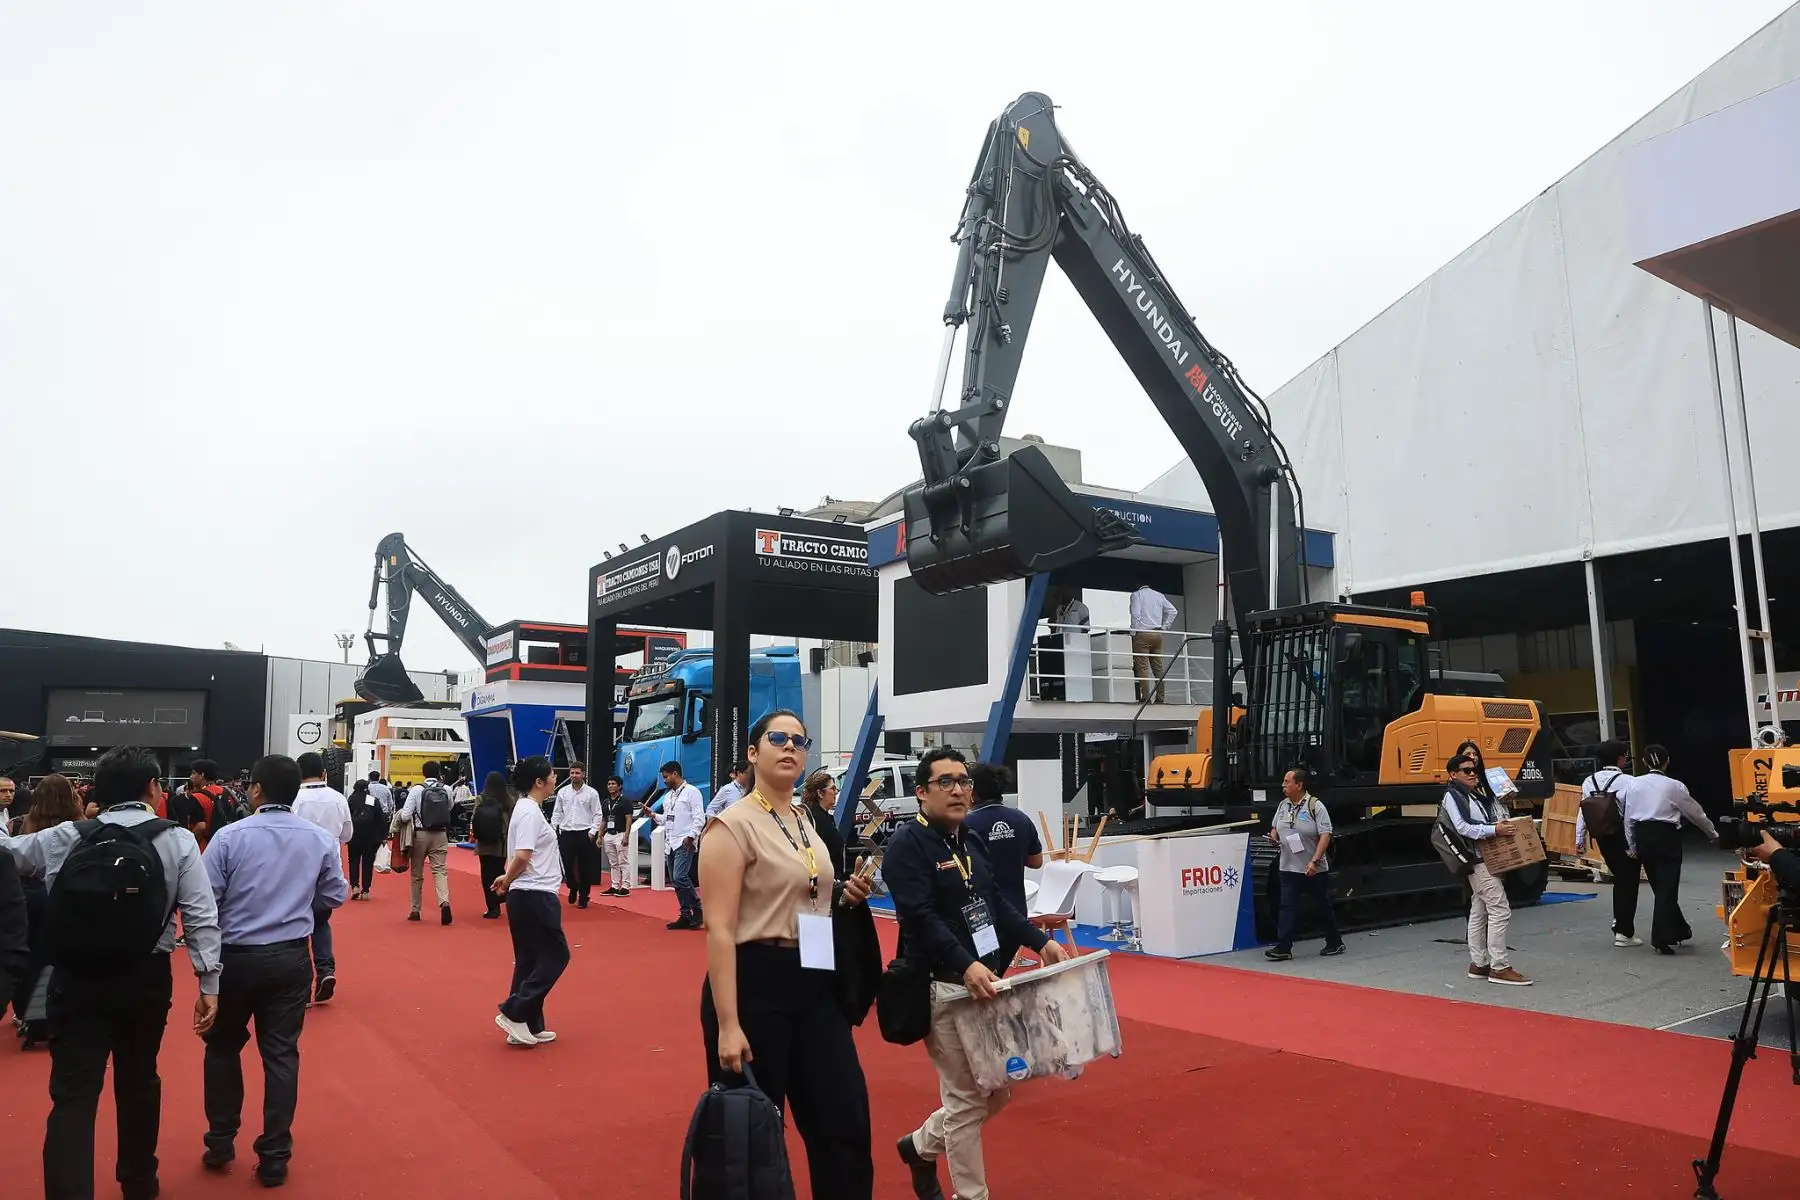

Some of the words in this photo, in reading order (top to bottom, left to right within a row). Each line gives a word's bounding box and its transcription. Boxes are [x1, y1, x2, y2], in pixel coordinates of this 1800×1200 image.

[1111, 258, 1190, 366] HYUNDAI
[1207, 382, 1243, 432] MAQUINARIAS
[1092, 506, 1152, 523] TRUCTION
[681, 545, 714, 566] FOTON
[782, 539, 828, 555] TRACTO
[830, 544, 868, 560] CAMIO
[622, 563, 648, 582] CAMIONES
[648, 559, 659, 575] USA
[758, 557, 770, 566] TU
[772, 558, 808, 571] ALIADO
[810, 562, 823, 572] EN
[825, 563, 842, 574] LAS
[844, 566, 872, 577] RUTAS
[435, 593, 469, 628] HYUNDAI
[1526, 760, 1536, 769] HX
[1753, 757, 1773, 771] 2
[1181, 865, 1222, 888] FRIO
[1182, 887, 1223, 896] Importaciones
